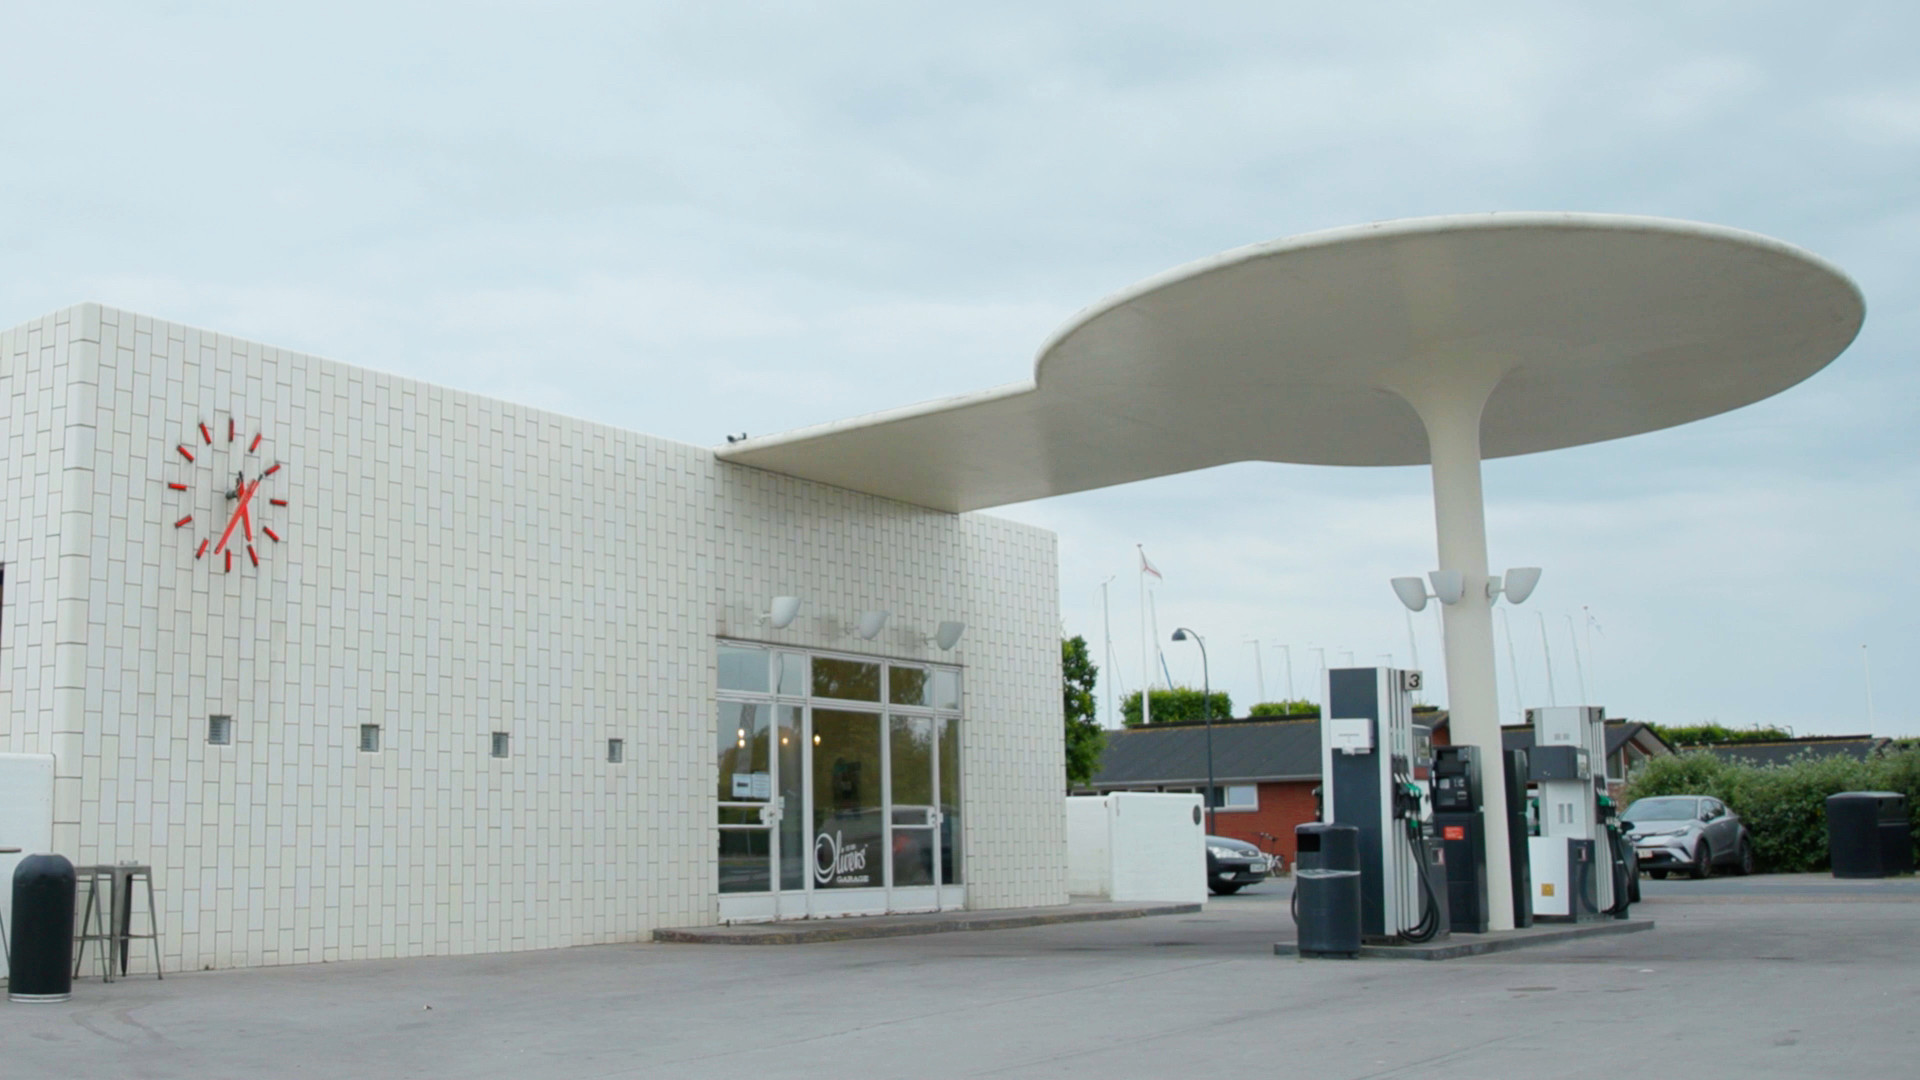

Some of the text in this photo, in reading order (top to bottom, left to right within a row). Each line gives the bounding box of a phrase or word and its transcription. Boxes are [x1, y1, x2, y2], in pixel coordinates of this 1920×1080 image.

[1409, 673, 1420, 688] 3
[1525, 710, 1534, 722] 2
[836, 875, 870, 883] GARAGE
